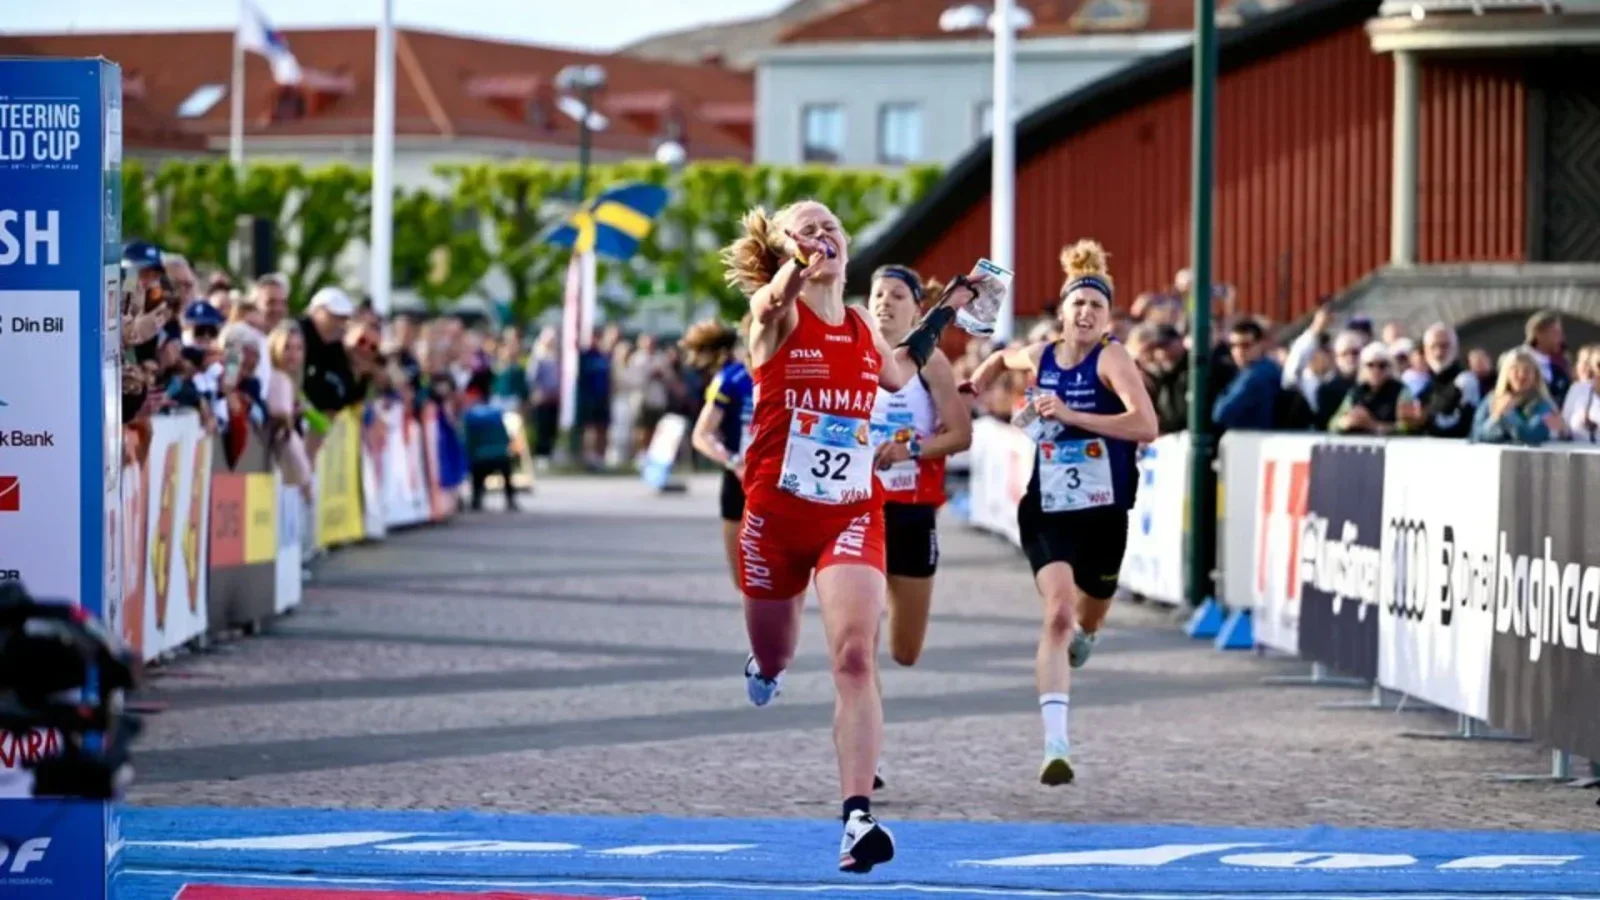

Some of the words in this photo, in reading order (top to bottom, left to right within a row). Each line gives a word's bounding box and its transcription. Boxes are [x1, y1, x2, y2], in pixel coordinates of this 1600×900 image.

[0, 104, 80, 128] TEERING
[33, 131, 80, 161] CUP
[0, 210, 60, 266] SH
[12, 317, 40, 333] Din
[43, 317, 63, 333] Bil
[790, 349, 823, 358] SILVA
[785, 388, 874, 412] DANMAR
[12, 431, 54, 446] Bank
[811, 448, 851, 480] 32
[1065, 467, 1081, 489] 3
